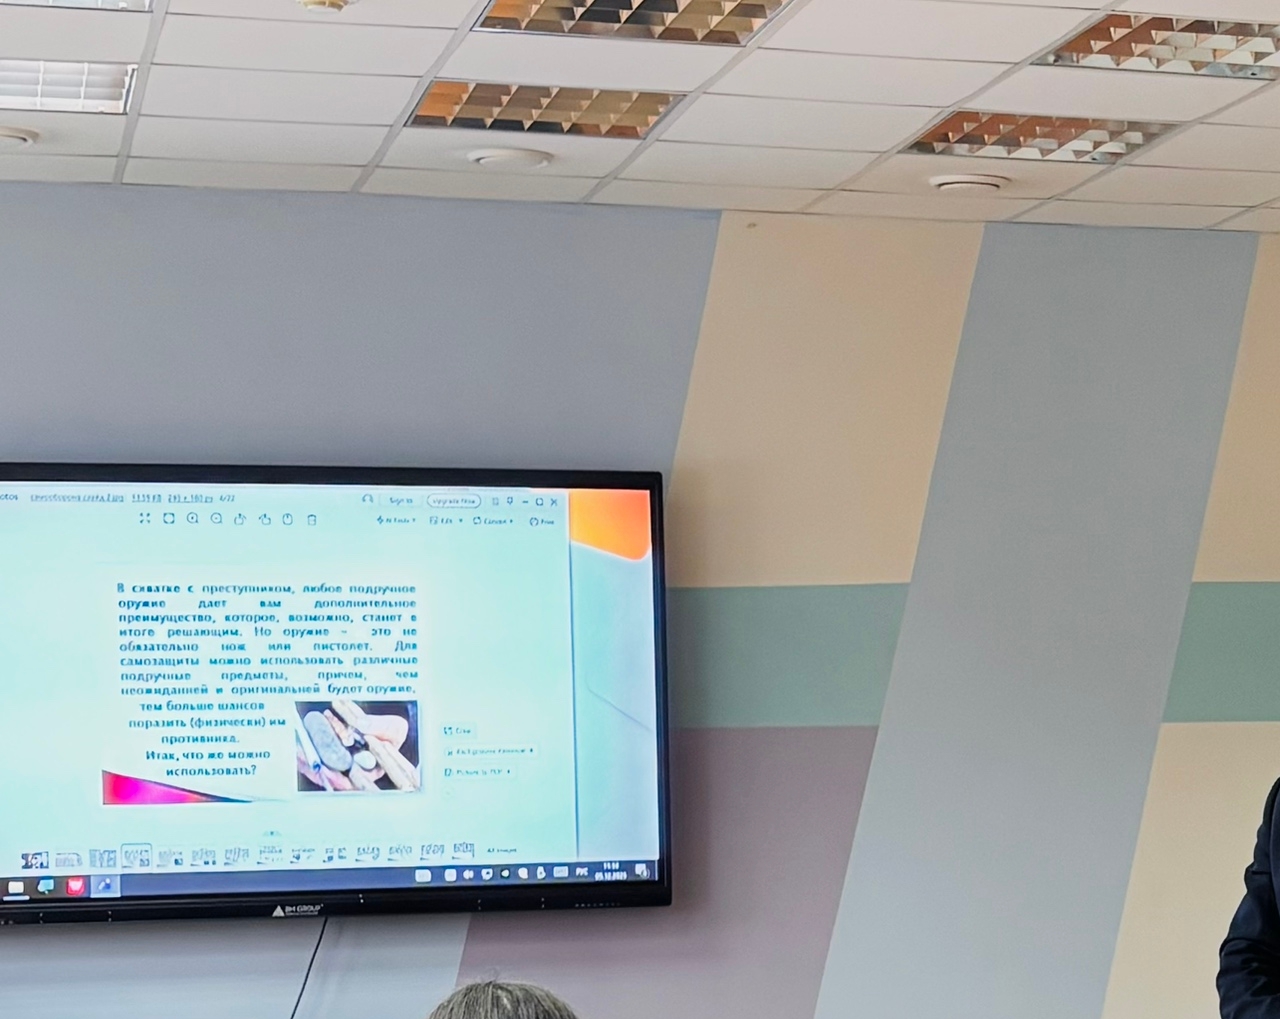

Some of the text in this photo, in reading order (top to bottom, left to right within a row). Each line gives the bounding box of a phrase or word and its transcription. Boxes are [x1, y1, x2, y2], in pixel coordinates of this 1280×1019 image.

[118, 599, 166, 611] оружие
[198, 599, 227, 609] дает
[314, 600, 416, 609] дополнительное
[119, 614, 216, 625] преимущество,
[224, 614, 280, 624] которое,
[288, 614, 354, 624] возможно,
[362, 614, 403, 622] станет
[119, 628, 156, 637] итоге
[254, 626, 272, 637] Но
[283, 628, 330, 638] оружие
[403, 628, 417, 636] не
[119, 641, 199, 652] обязательно
[120, 656, 418, 667] самозащиты можно использовать различные
[121, 672, 192, 683] подручные
[121, 684, 209, 696] неожиданней
[231, 683, 320, 696] оригинальней
[166, 700, 214, 711] больше
[218, 701, 265, 711] шансов
[129, 718, 187, 729] поразить
[166, 764, 257, 776] использовать?
